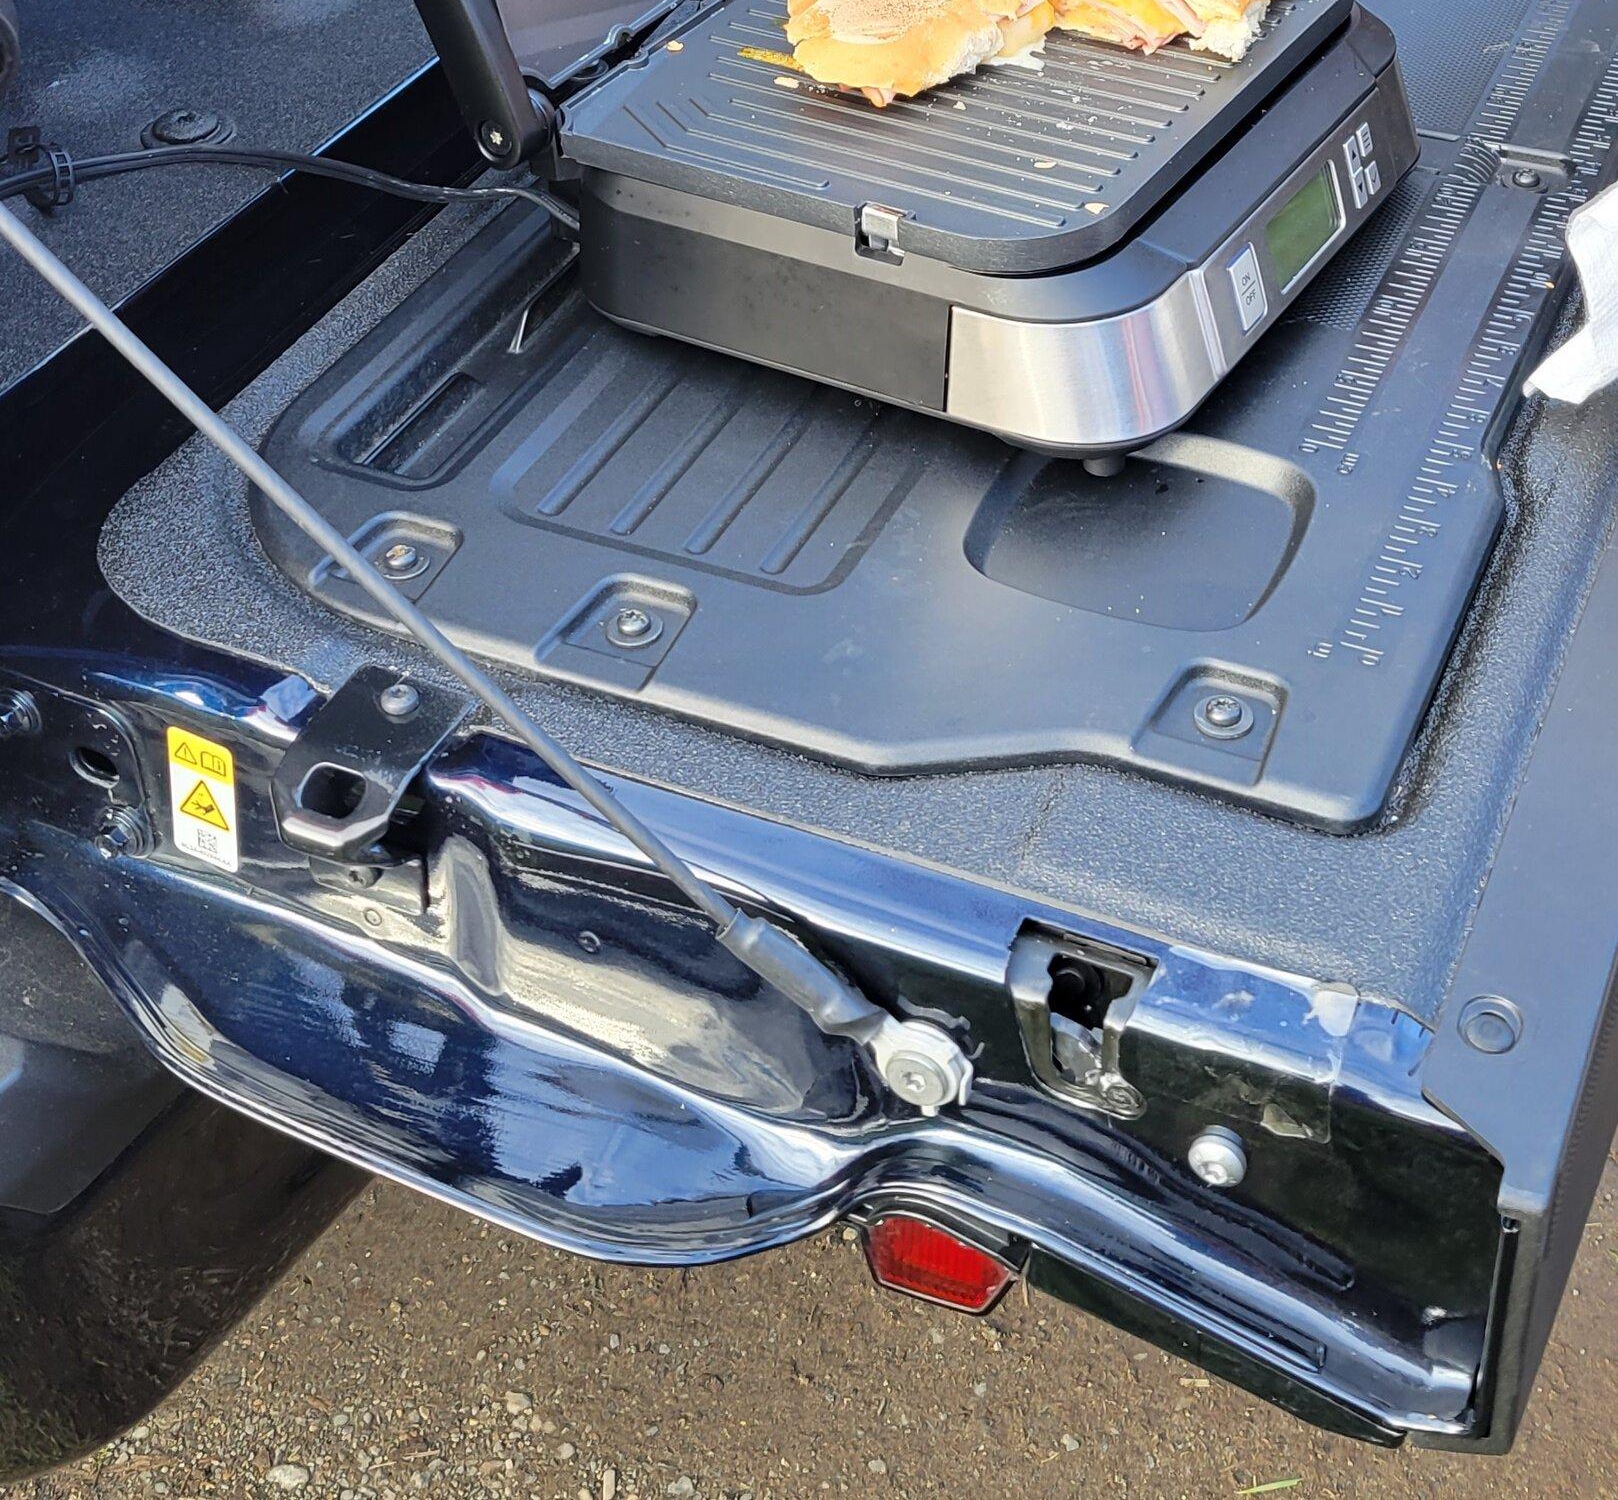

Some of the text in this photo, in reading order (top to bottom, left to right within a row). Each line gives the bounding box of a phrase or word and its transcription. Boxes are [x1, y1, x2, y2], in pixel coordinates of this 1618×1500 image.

[1404, 240, 1426, 258] 15
[1541, 243, 1565, 260] 11
[1241, 272, 1252, 287] ON
[1528, 271, 1552, 289] 10
[1245, 288, 1257, 307] OFF
[1371, 299, 1397, 317] 10
[1513, 313, 1533, 324] 9
[1497, 345, 1518, 356] 8
[1335, 374, 1356, 384] 5
[1482, 377, 1504, 388] 7
[1467, 411, 1487, 423] 6
[1299, 442, 1319, 454] 0
[1450, 448, 1472, 460] 5
[1337, 452, 1360, 476] cm
[1435, 486, 1456, 498] 4
[1418, 526, 1438, 538] 3
[1400, 566, 1423, 580] 2
[1380, 607, 1403, 617] 1
[1306, 642, 1334, 659] in
[1360, 652, 1381, 666] 0
